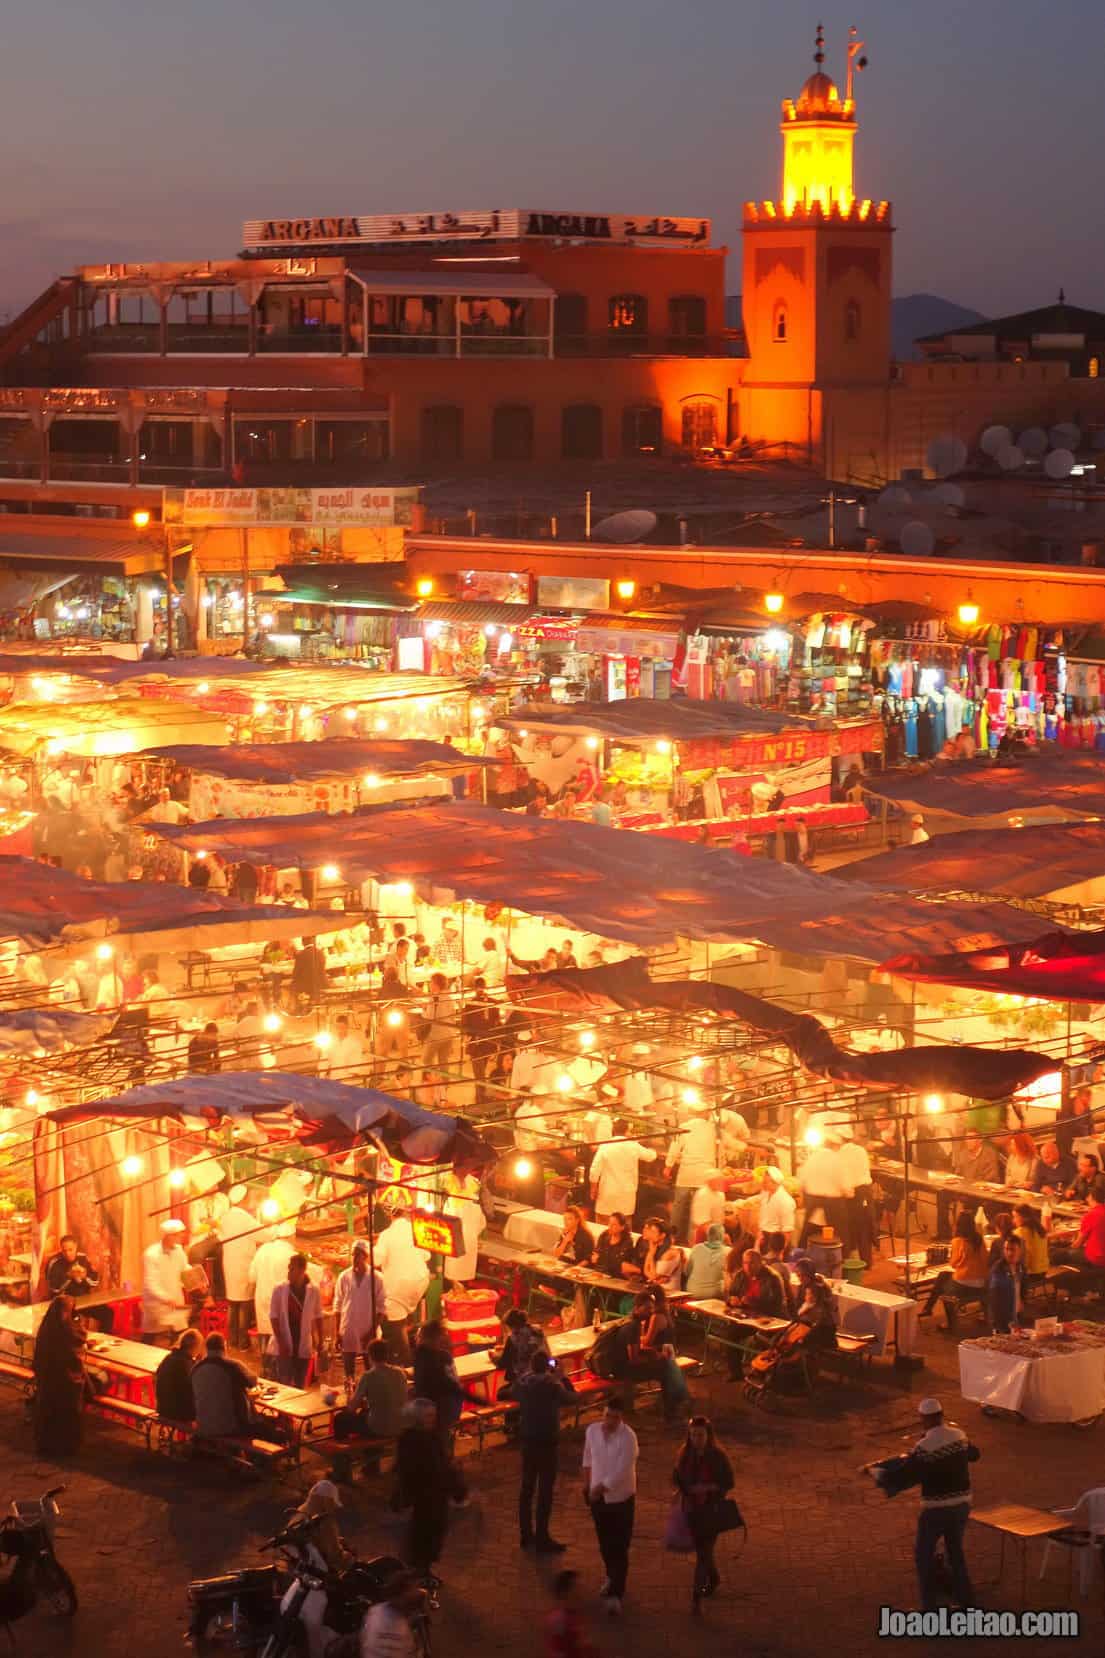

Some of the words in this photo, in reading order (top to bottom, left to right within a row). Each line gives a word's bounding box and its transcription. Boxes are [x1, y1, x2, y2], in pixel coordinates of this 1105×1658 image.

[263, 217, 360, 240] ARGANA
[527, 214, 610, 238] ARGANA
[509, 626, 544, 637] PZZA
